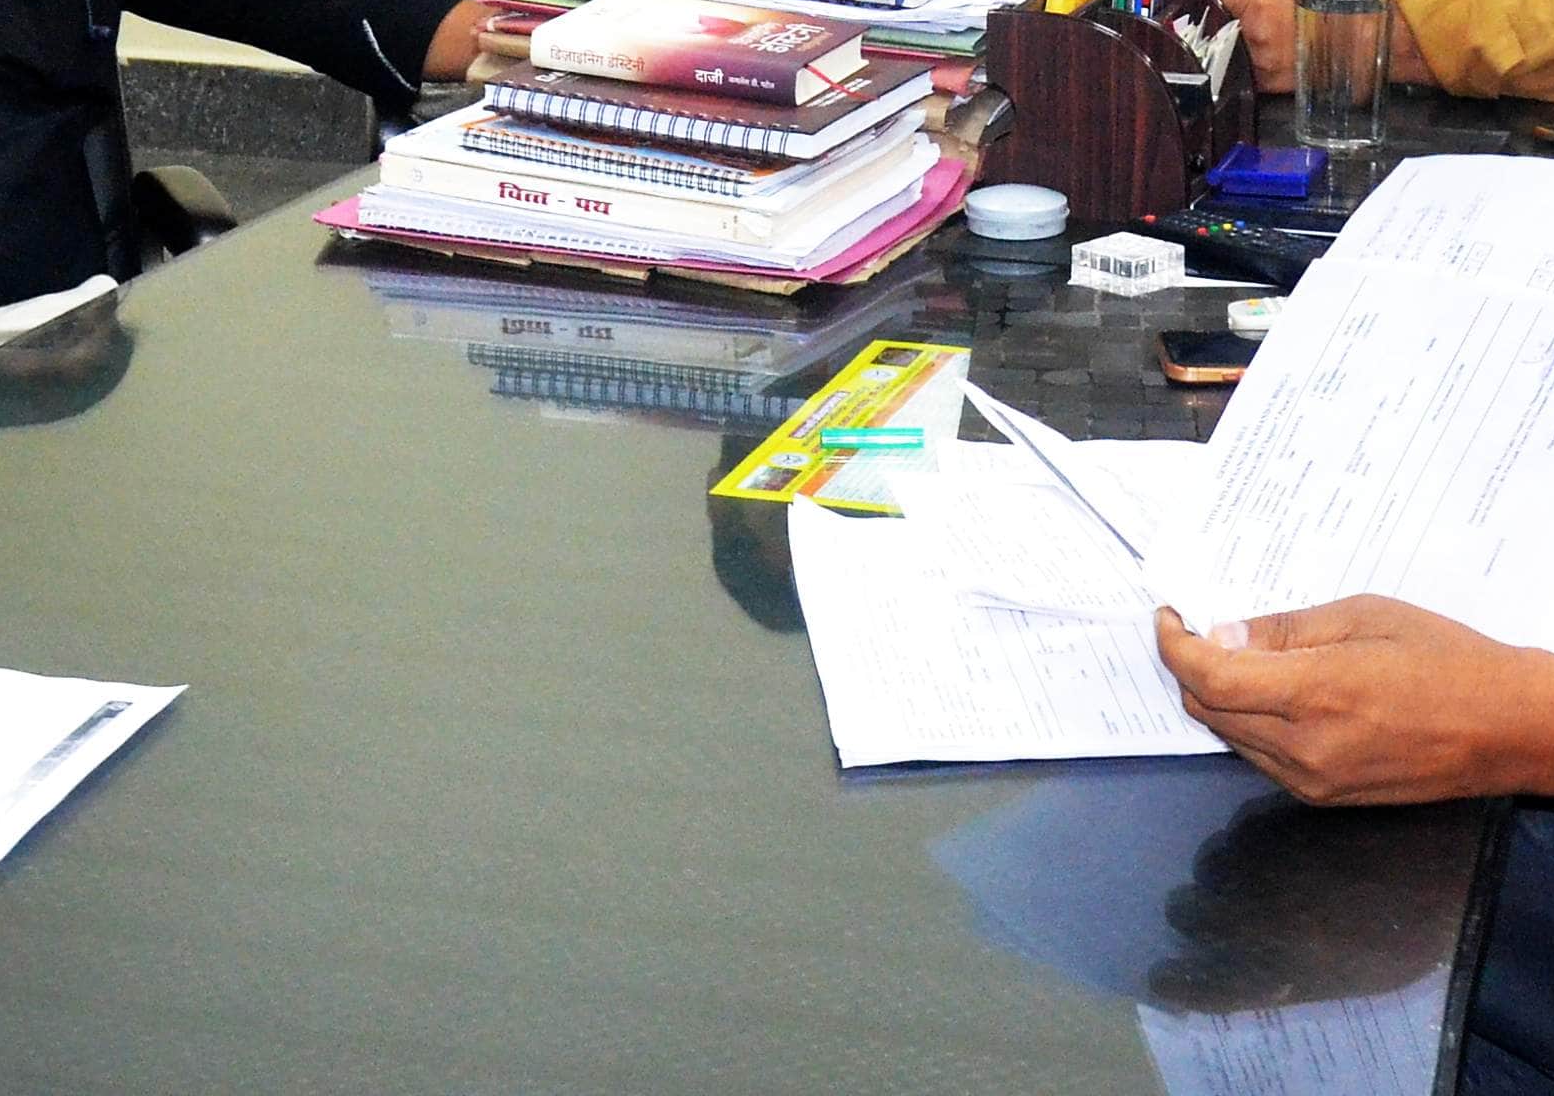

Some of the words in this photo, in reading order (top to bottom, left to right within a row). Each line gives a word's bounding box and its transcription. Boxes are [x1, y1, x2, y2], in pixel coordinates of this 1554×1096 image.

[694, 69, 724, 85] दाजी
[498, 181, 551, 206] वित्त
[574, 196, 613, 215] पथ
